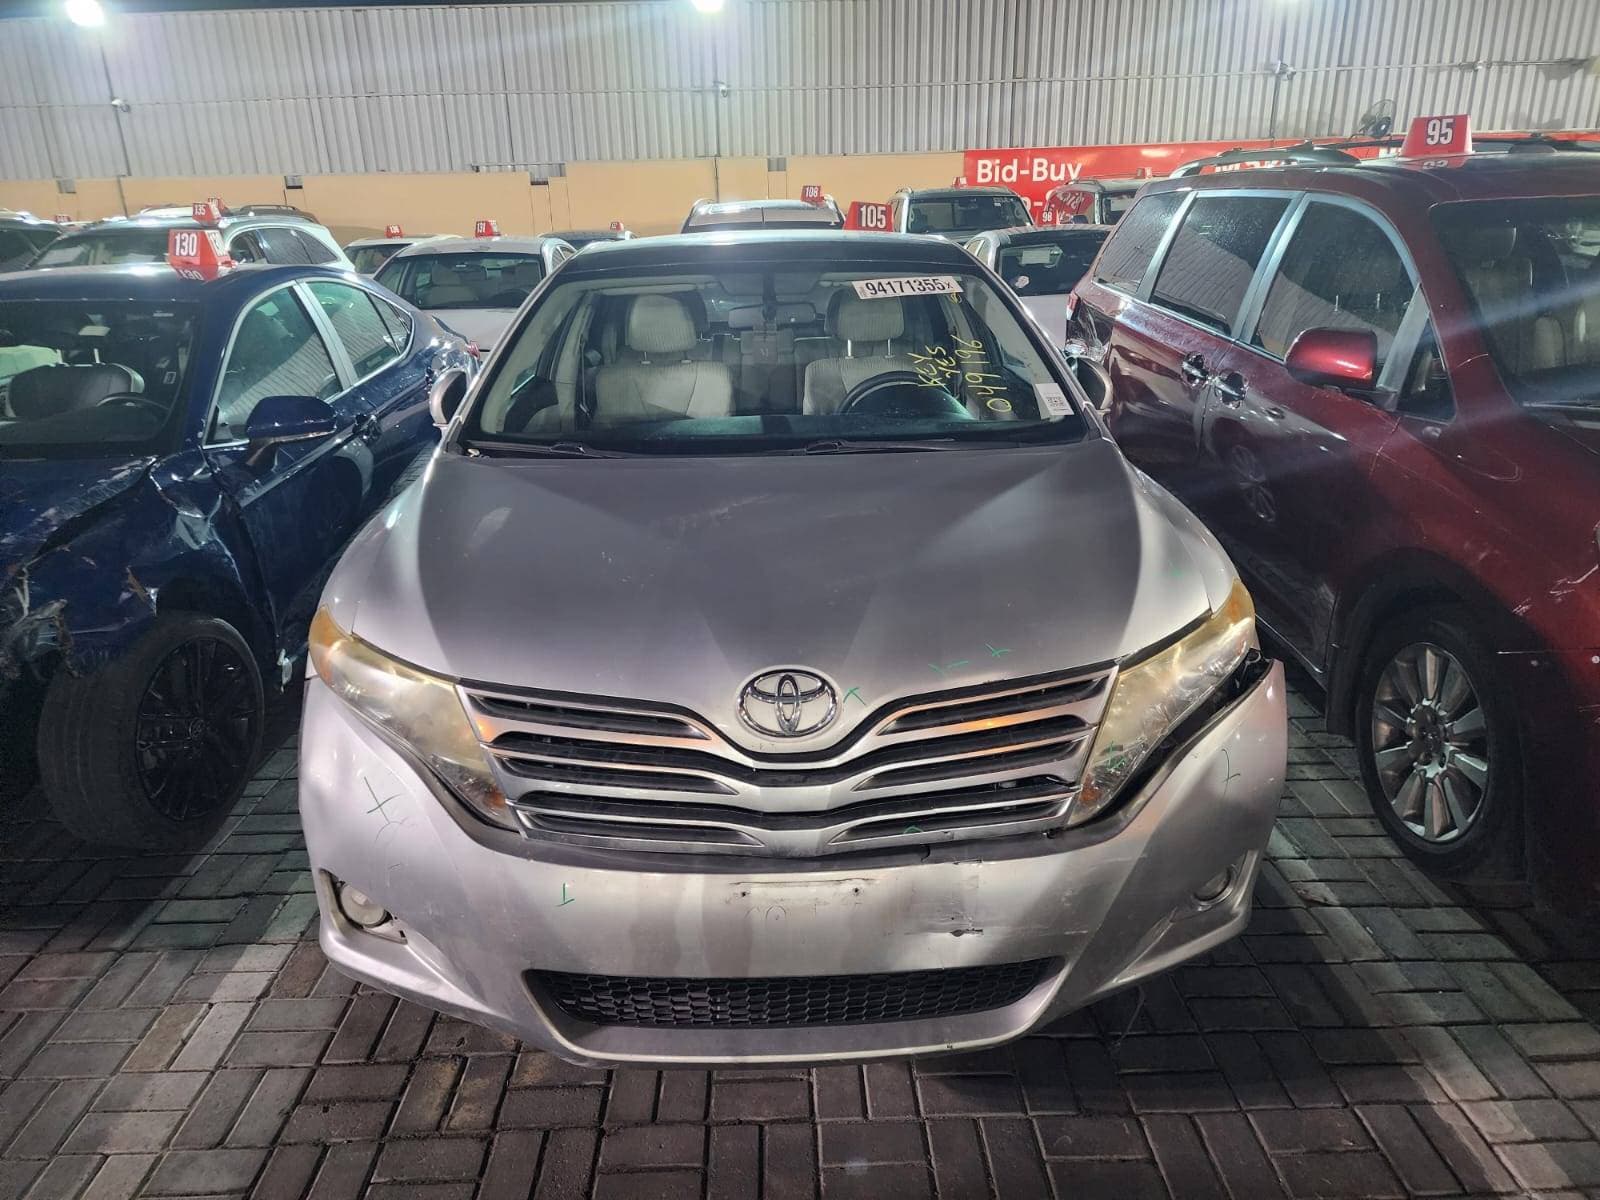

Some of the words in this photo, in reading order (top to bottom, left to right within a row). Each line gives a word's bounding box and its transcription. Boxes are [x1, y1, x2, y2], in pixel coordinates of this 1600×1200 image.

[1426, 118, 1454, 145] 95
[977, 158, 1082, 184] Bid-Buy
[860, 204, 886, 229] 105
[1042, 211, 1053, 222] 98
[175, 232, 197, 256] 130
